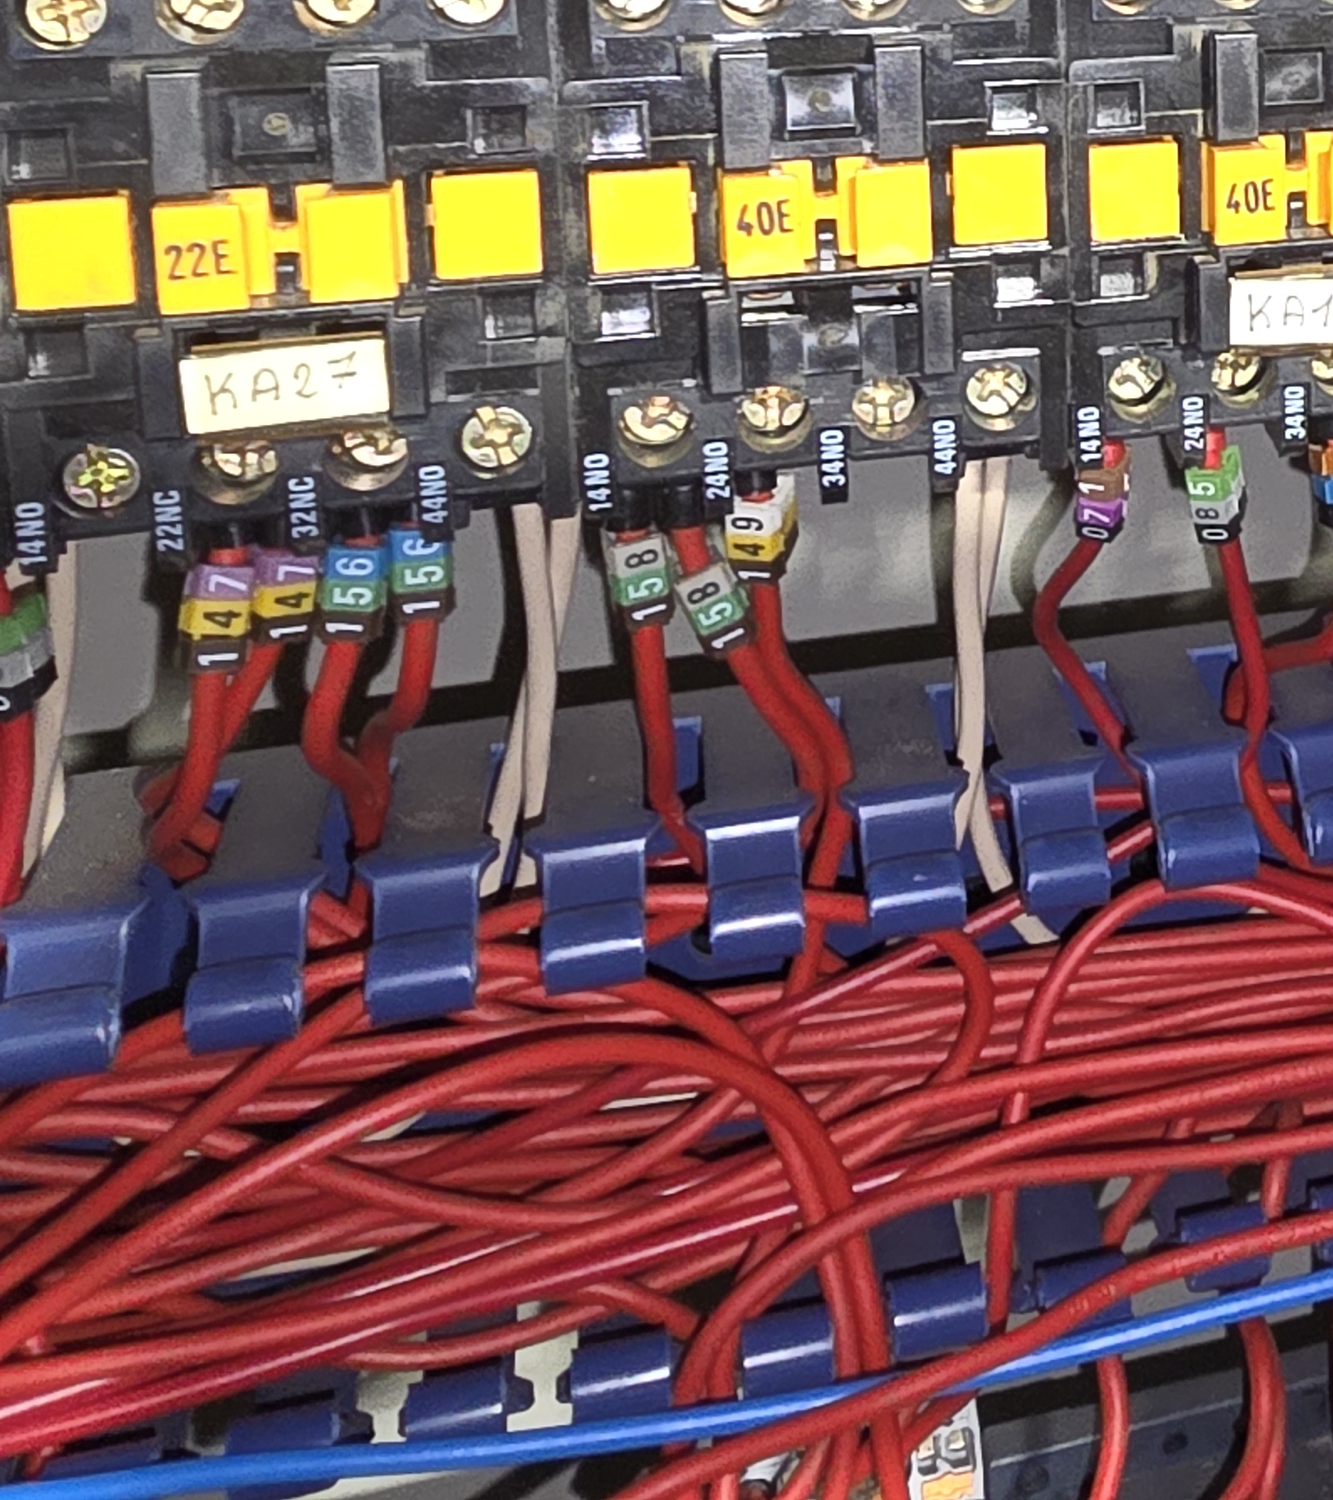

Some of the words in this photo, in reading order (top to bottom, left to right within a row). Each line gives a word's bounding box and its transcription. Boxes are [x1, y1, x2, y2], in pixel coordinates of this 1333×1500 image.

[735, 198, 796, 238] 40E
[1225, 177, 1277, 215] 40E
[163, 238, 239, 282] 22E
[204, 350, 358, 417] KA27
[1283, 384, 1307, 440] 34NO
[932, 418, 957, 476] 44NO
[1077, 405, 1102, 464] 14NO
[1184, 394, 1205, 452] 24NO
[583, 452, 612, 512] 14NO
[702, 440, 731, 501] 24NO
[819, 428, 846, 488] 34NO
[153, 489, 184, 553] 22NC
[287, 475, 319, 539] 32NC
[417, 464, 446, 525] 44NO
[14, 501, 48, 566] 14NO
